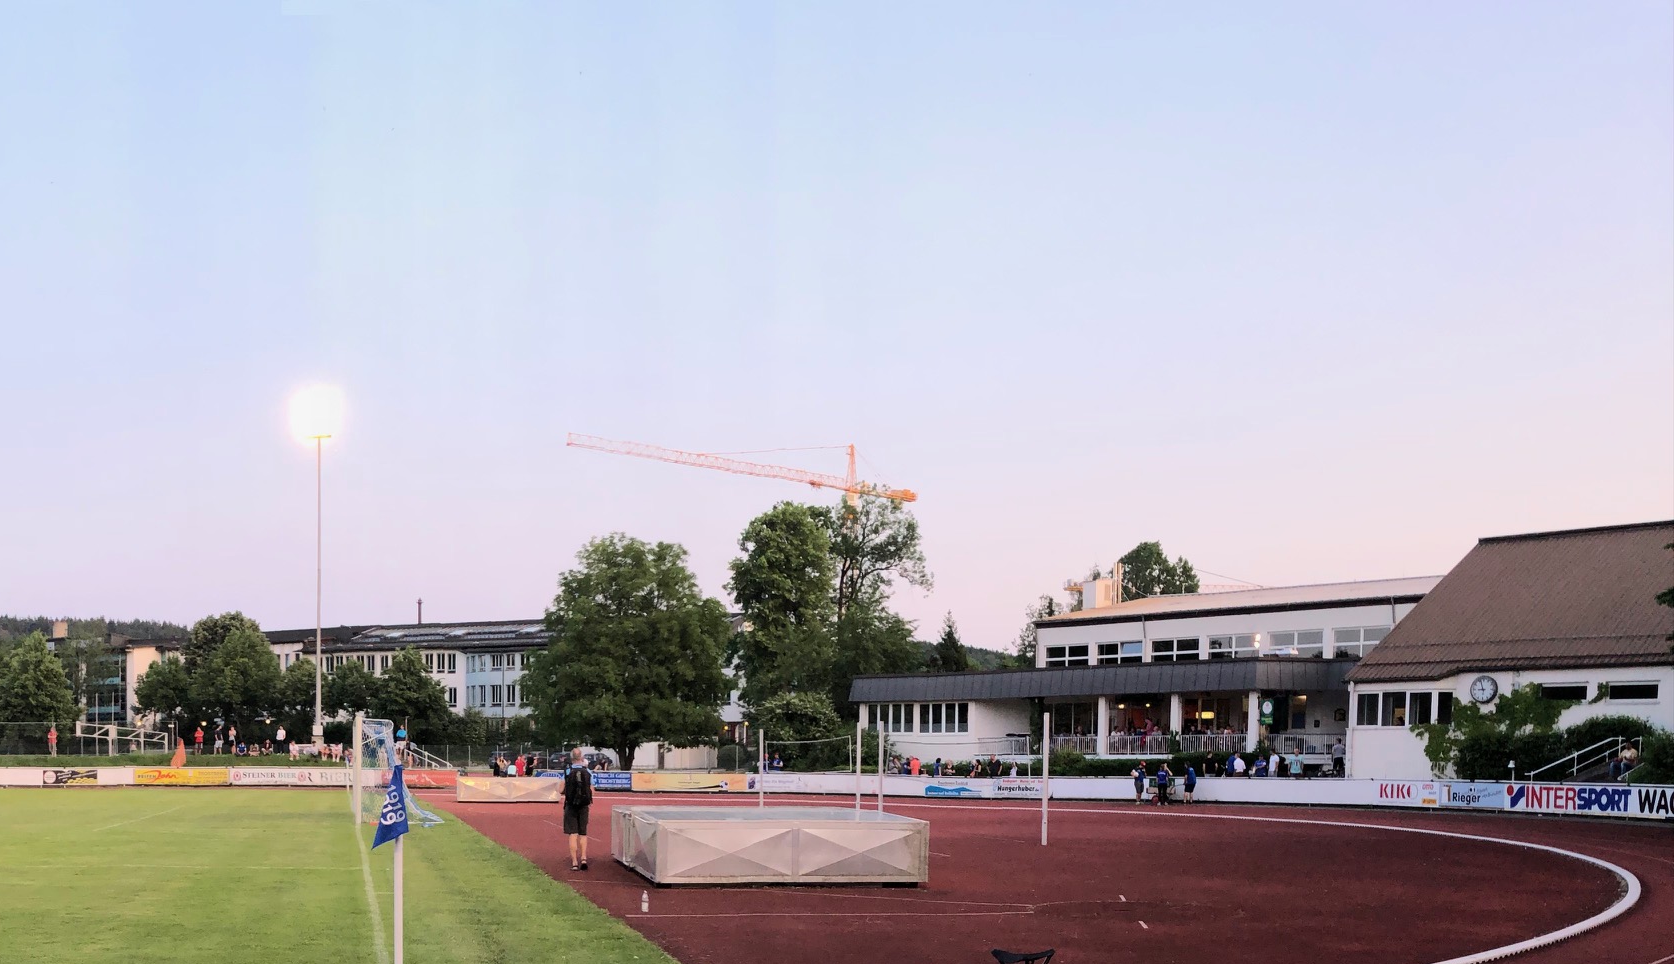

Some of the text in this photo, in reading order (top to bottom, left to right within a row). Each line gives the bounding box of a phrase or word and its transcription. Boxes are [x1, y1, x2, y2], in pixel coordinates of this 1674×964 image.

[1379, 783, 1419, 799] KIKO
[1452, 792, 1481, 805] Rieger
[1525, 785, 1632, 812] INTERSPORT
